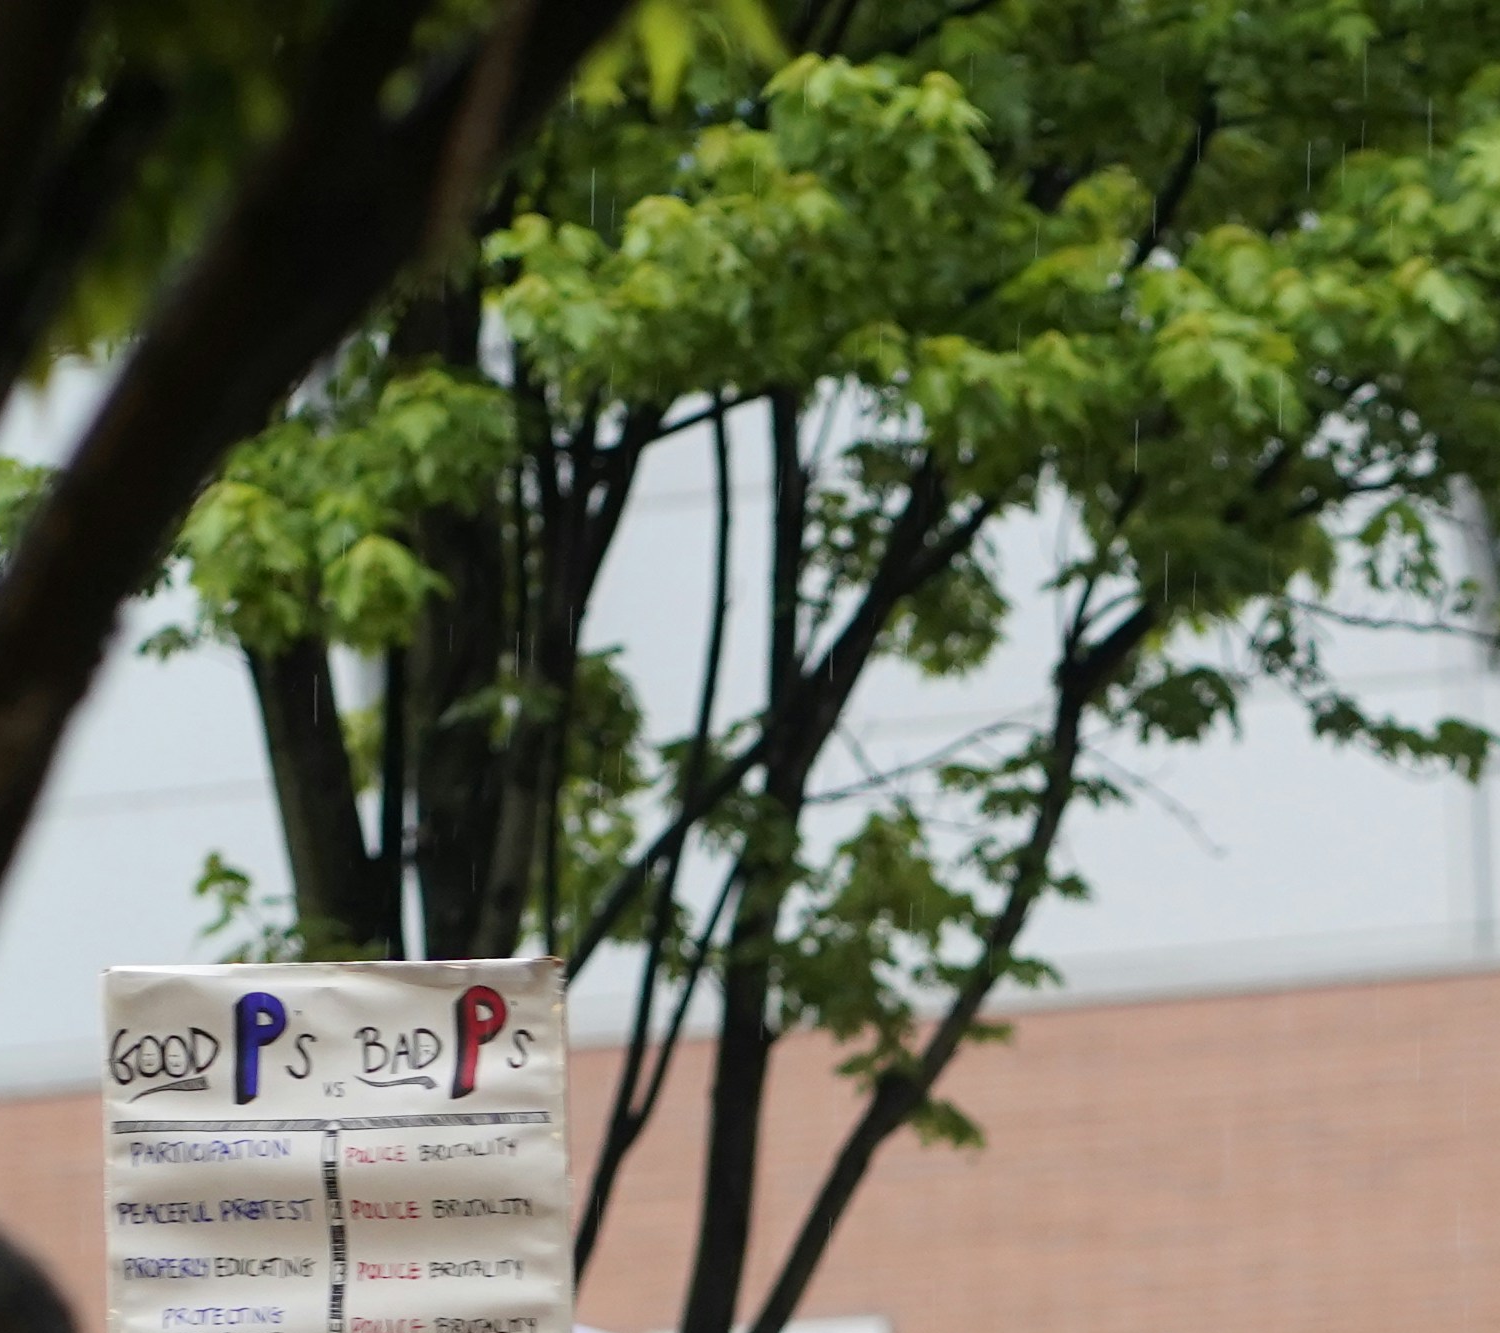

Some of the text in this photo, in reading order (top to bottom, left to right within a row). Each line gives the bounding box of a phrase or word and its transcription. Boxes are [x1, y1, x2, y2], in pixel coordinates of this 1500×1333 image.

[110, 1027, 219, 1085] GOOD
[354, 1026, 443, 1074] BAD
[130, 1138, 291, 1166] PARTICIPATION
[345, 1137, 519, 1167] POLICE BRUTALITY
[116, 1198, 315, 1225] PEACEFUL PROTEST
[351, 1198, 534, 1219] POLICE BRUTALITY
[357, 1259, 524, 1281] POLICE BRUTALITY
[162, 1307, 285, 1328] PROTECTING
